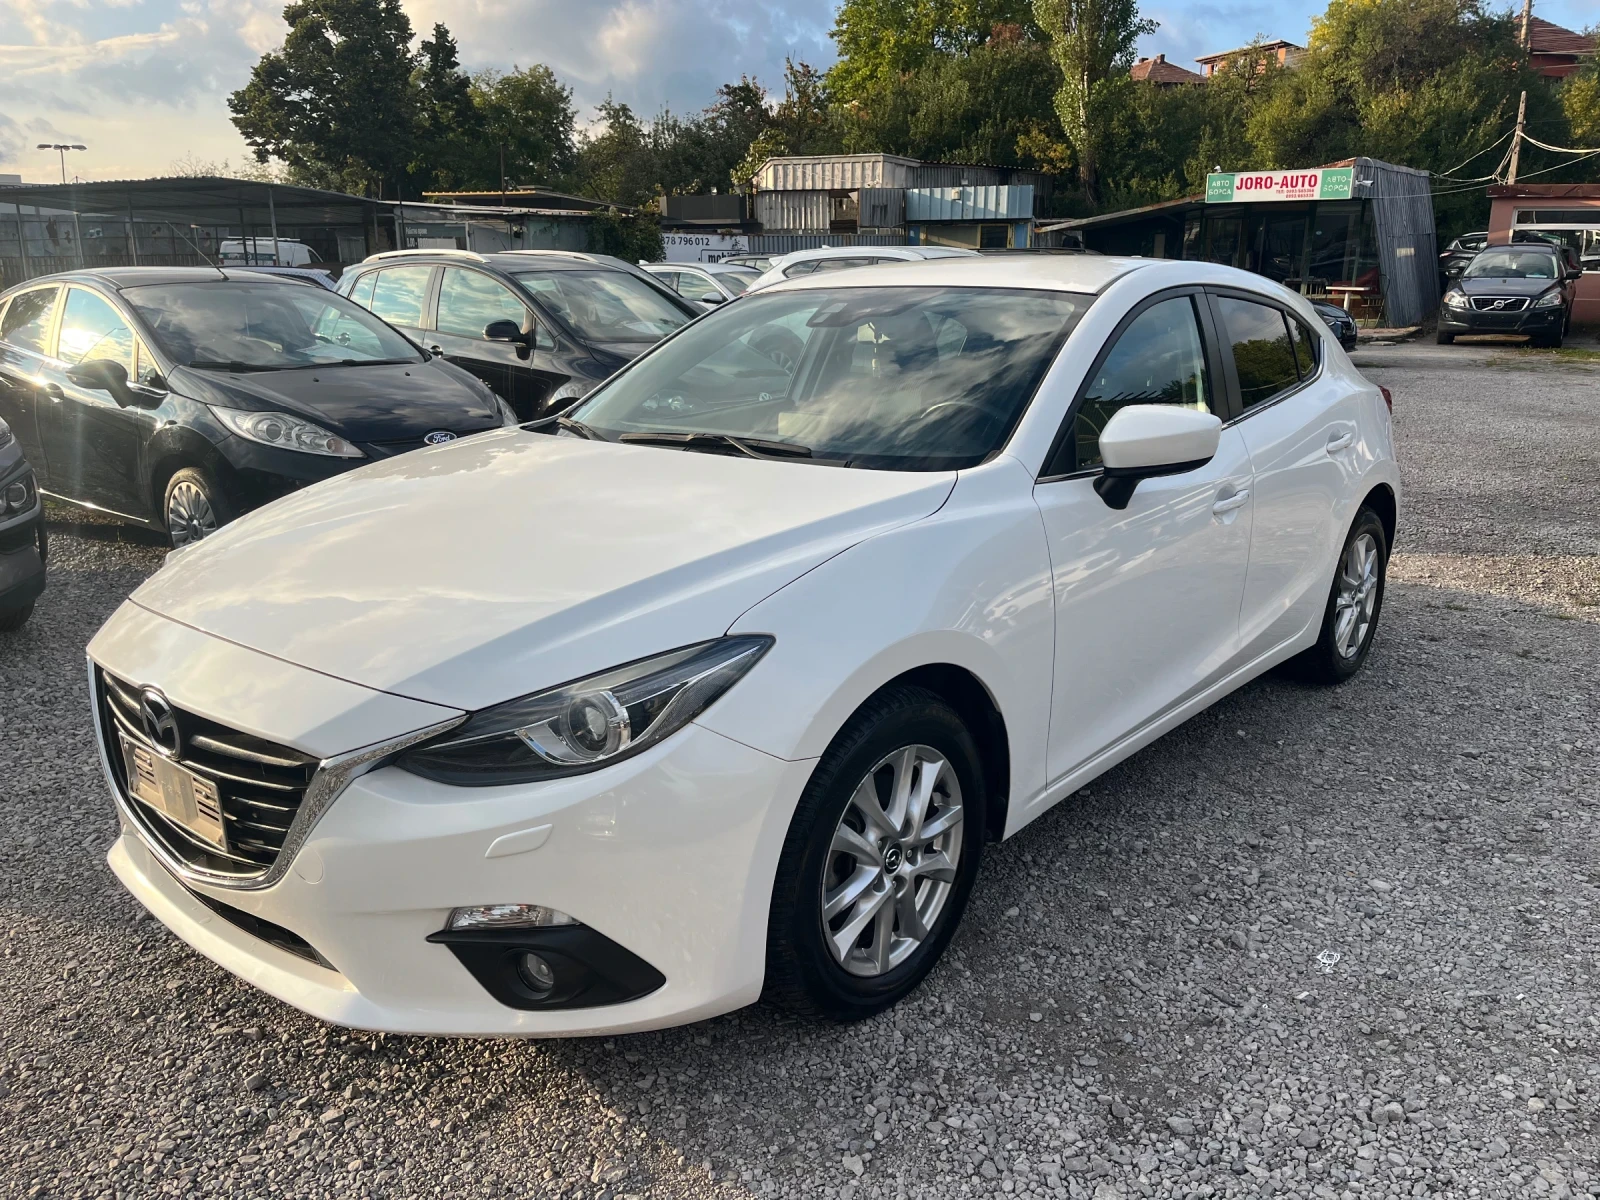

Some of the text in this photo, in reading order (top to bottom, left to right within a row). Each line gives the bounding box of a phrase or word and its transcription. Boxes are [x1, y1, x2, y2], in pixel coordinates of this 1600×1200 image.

[1236, 174, 1318, 190] JORO-AUTO
[1208, 188, 1232, 196] БОРСА
[1322, 184, 1349, 192] БОРСА
[678, 236, 694, 246] 796
[695, 237, 710, 246] 012
[433, 433, 450, 443] Ford
